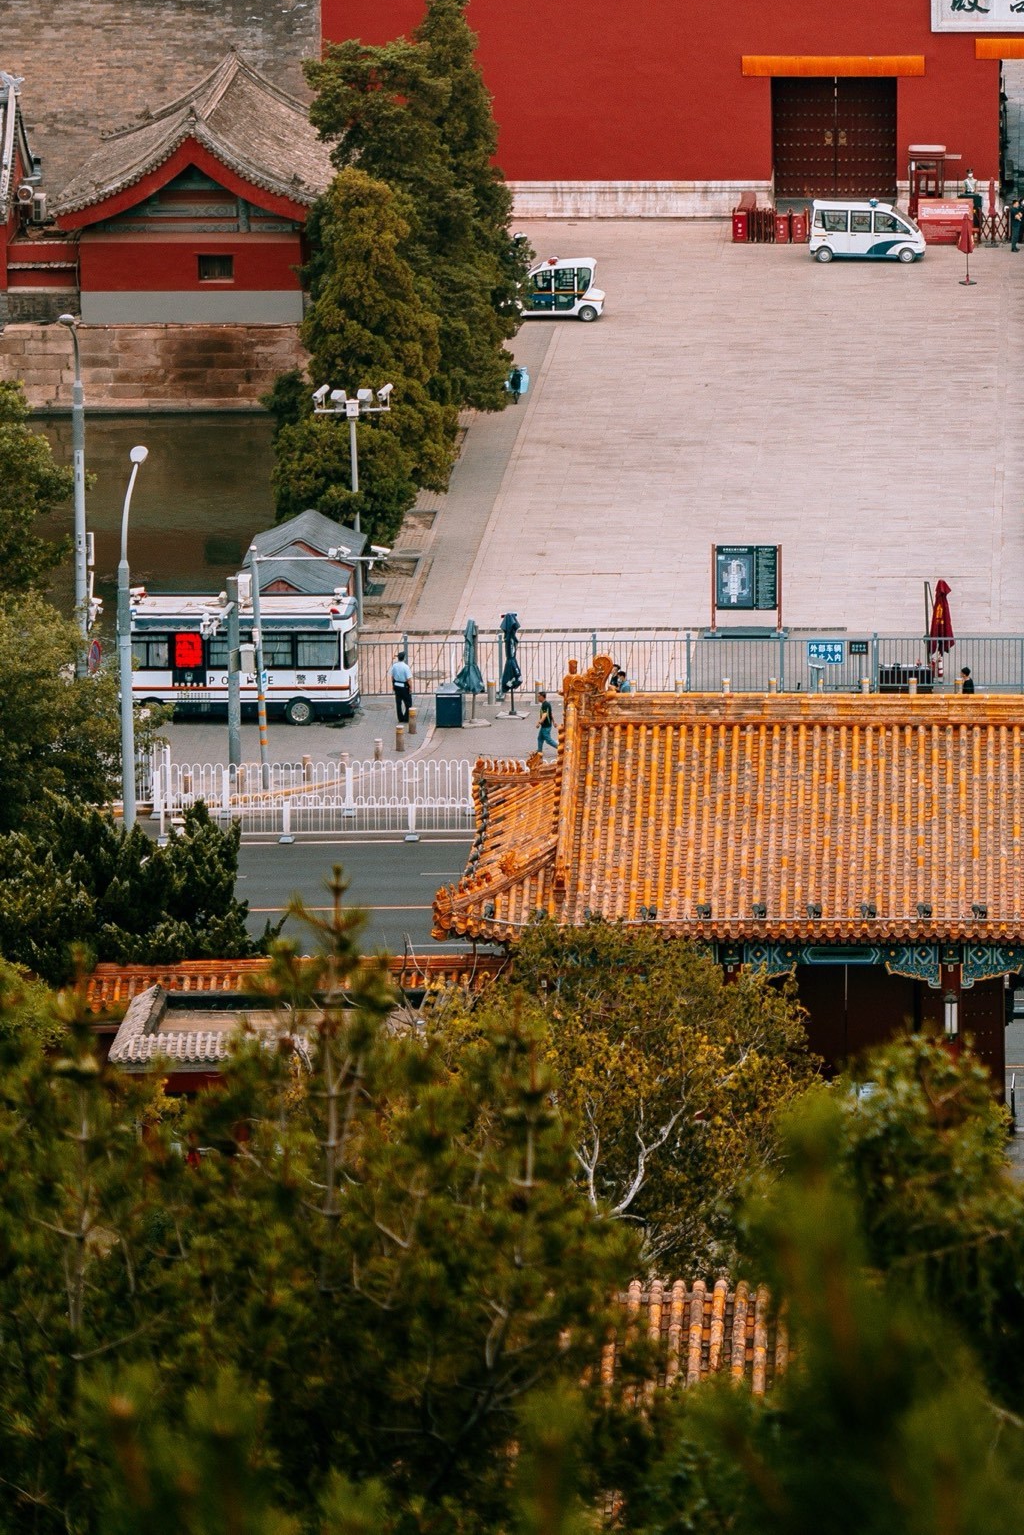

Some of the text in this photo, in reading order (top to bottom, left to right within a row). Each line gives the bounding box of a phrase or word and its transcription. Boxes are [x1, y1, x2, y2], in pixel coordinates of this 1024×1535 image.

[810, 644, 842, 652] 外部车辆
[296, 674, 328, 685] 警察
